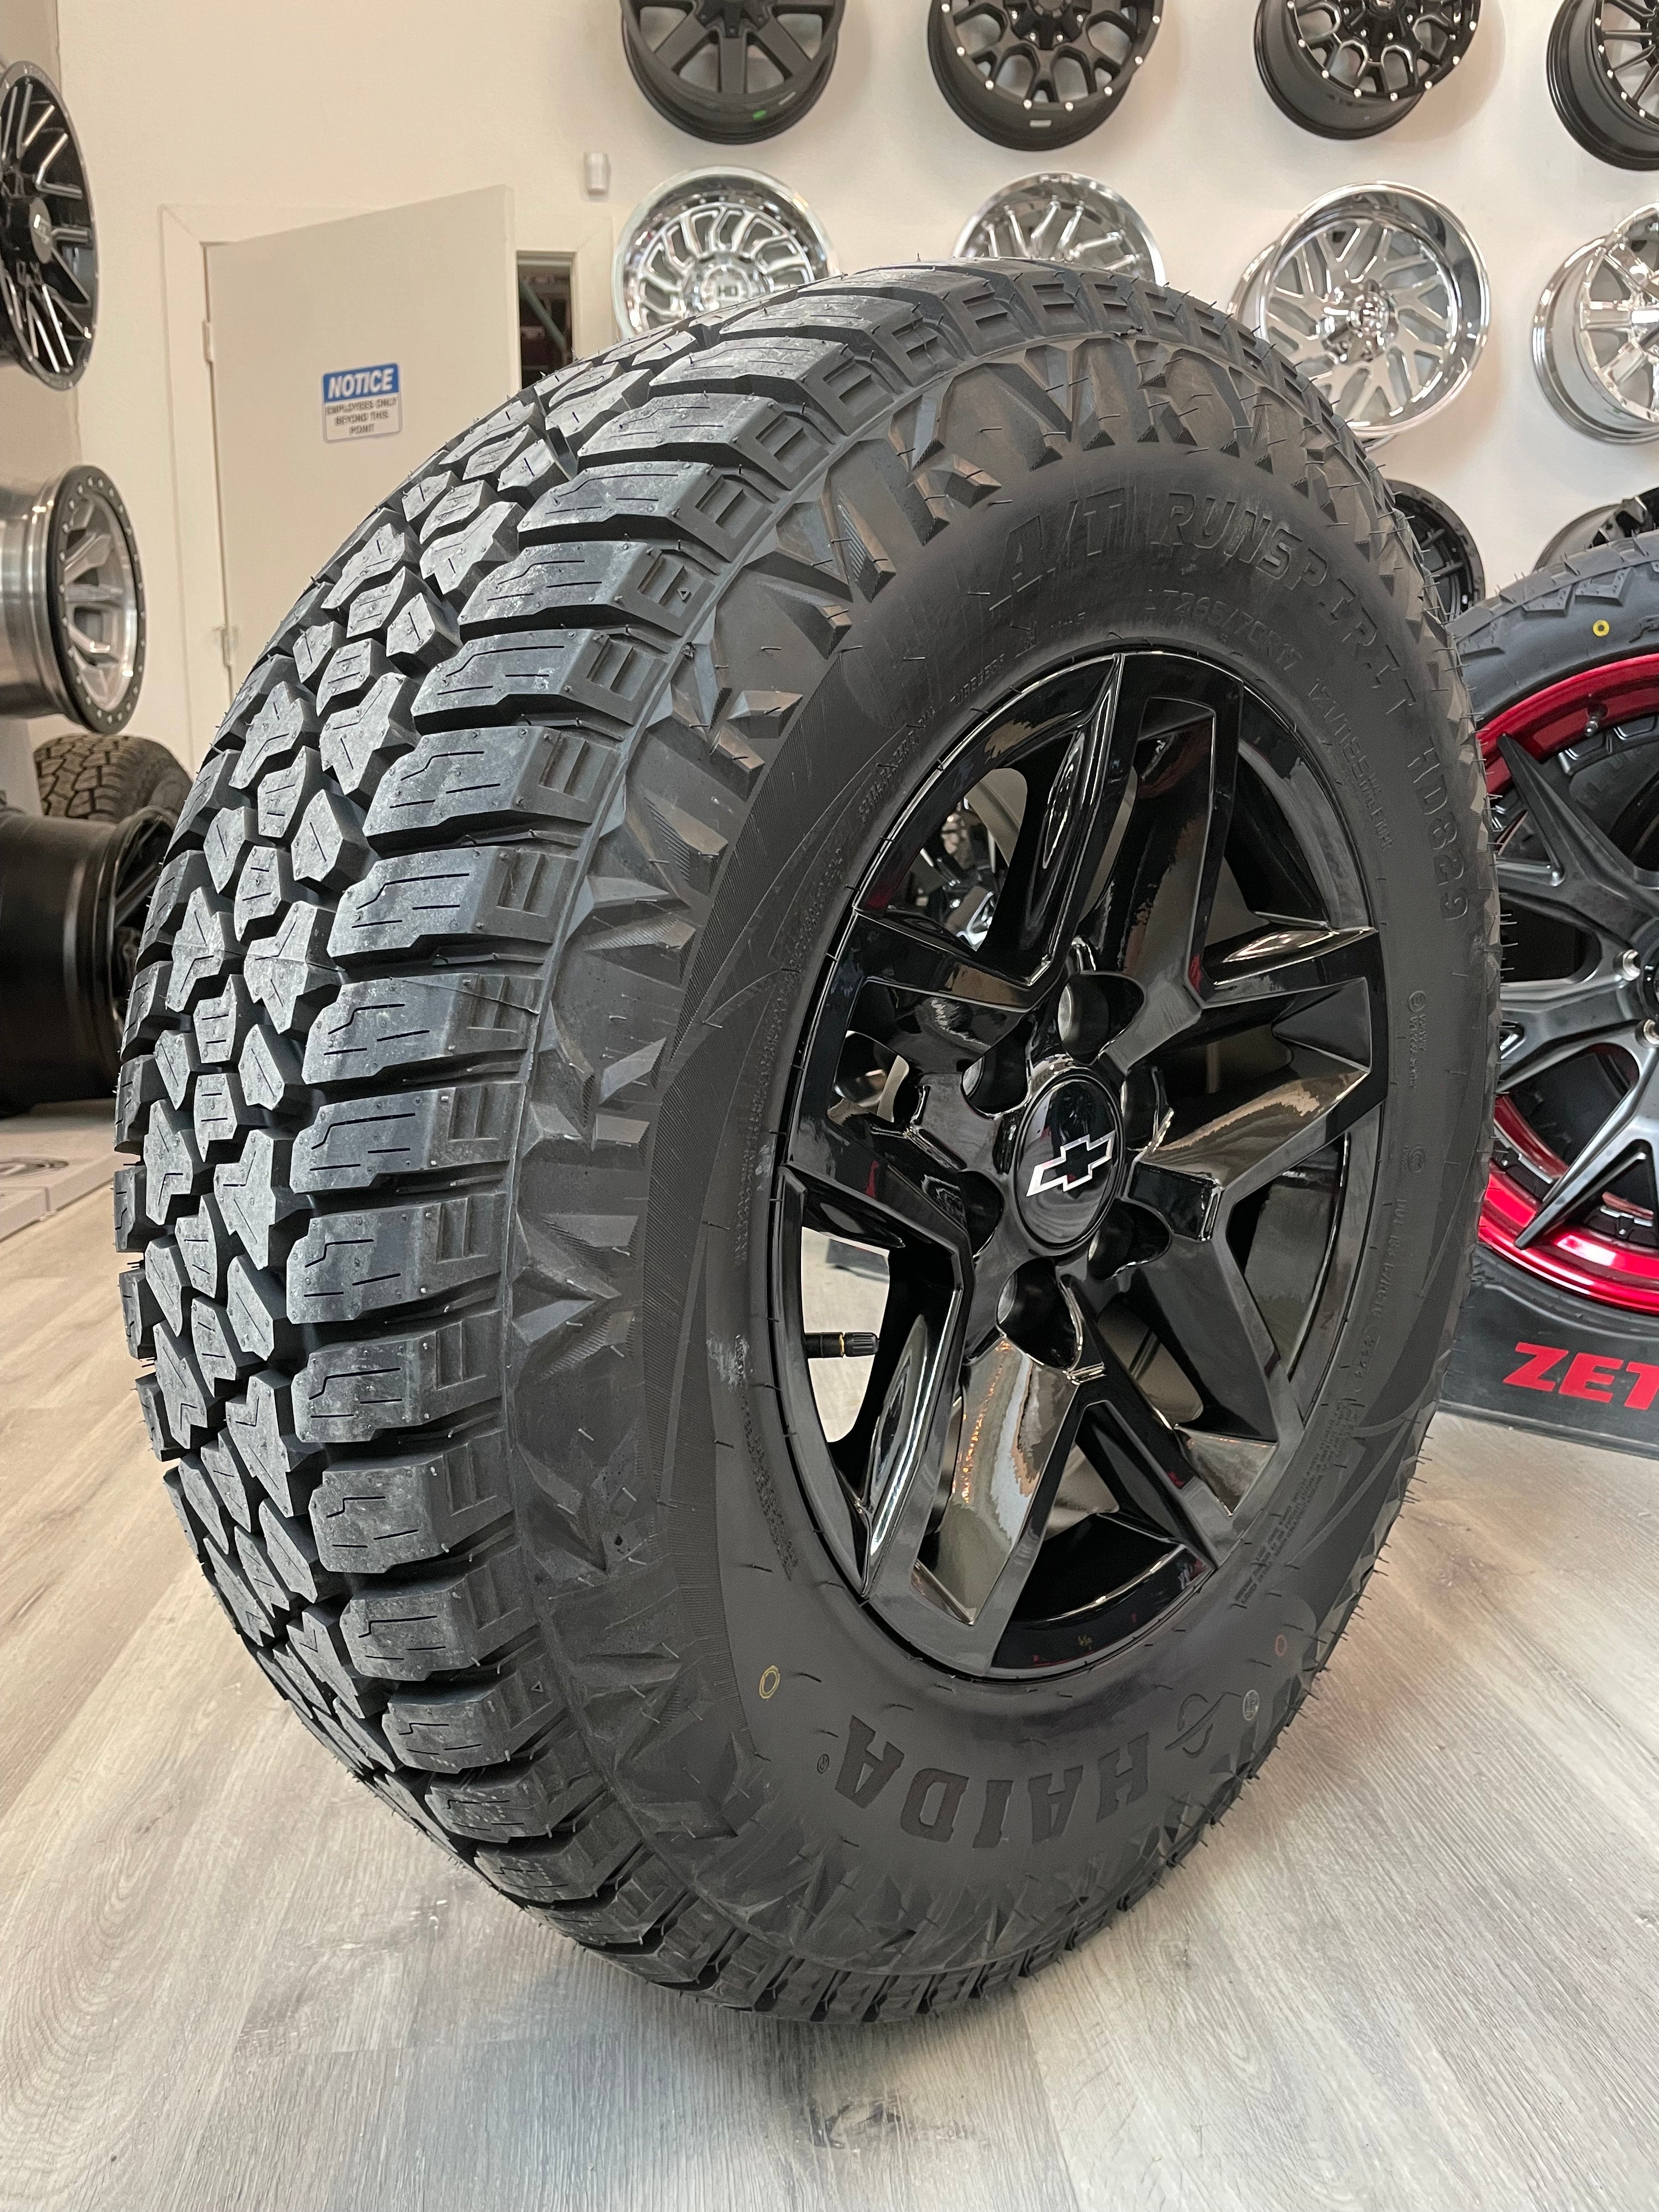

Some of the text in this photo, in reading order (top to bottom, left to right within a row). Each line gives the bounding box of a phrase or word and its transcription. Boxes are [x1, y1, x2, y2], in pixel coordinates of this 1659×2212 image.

[328, 368, 394, 399] NOTICE
[335, 410, 389, 425] BEYOND THIS
[349, 424, 375, 435] POINT
[950, 653, 1006, 706] TUBELESS
[1150, 492, 1417, 714] RUNSPIRIT
[1406, 736, 1470, 922] HD829
[1503, 1341, 1659, 1410] ZET
[834, 1714, 1150, 1849] HAIDA
